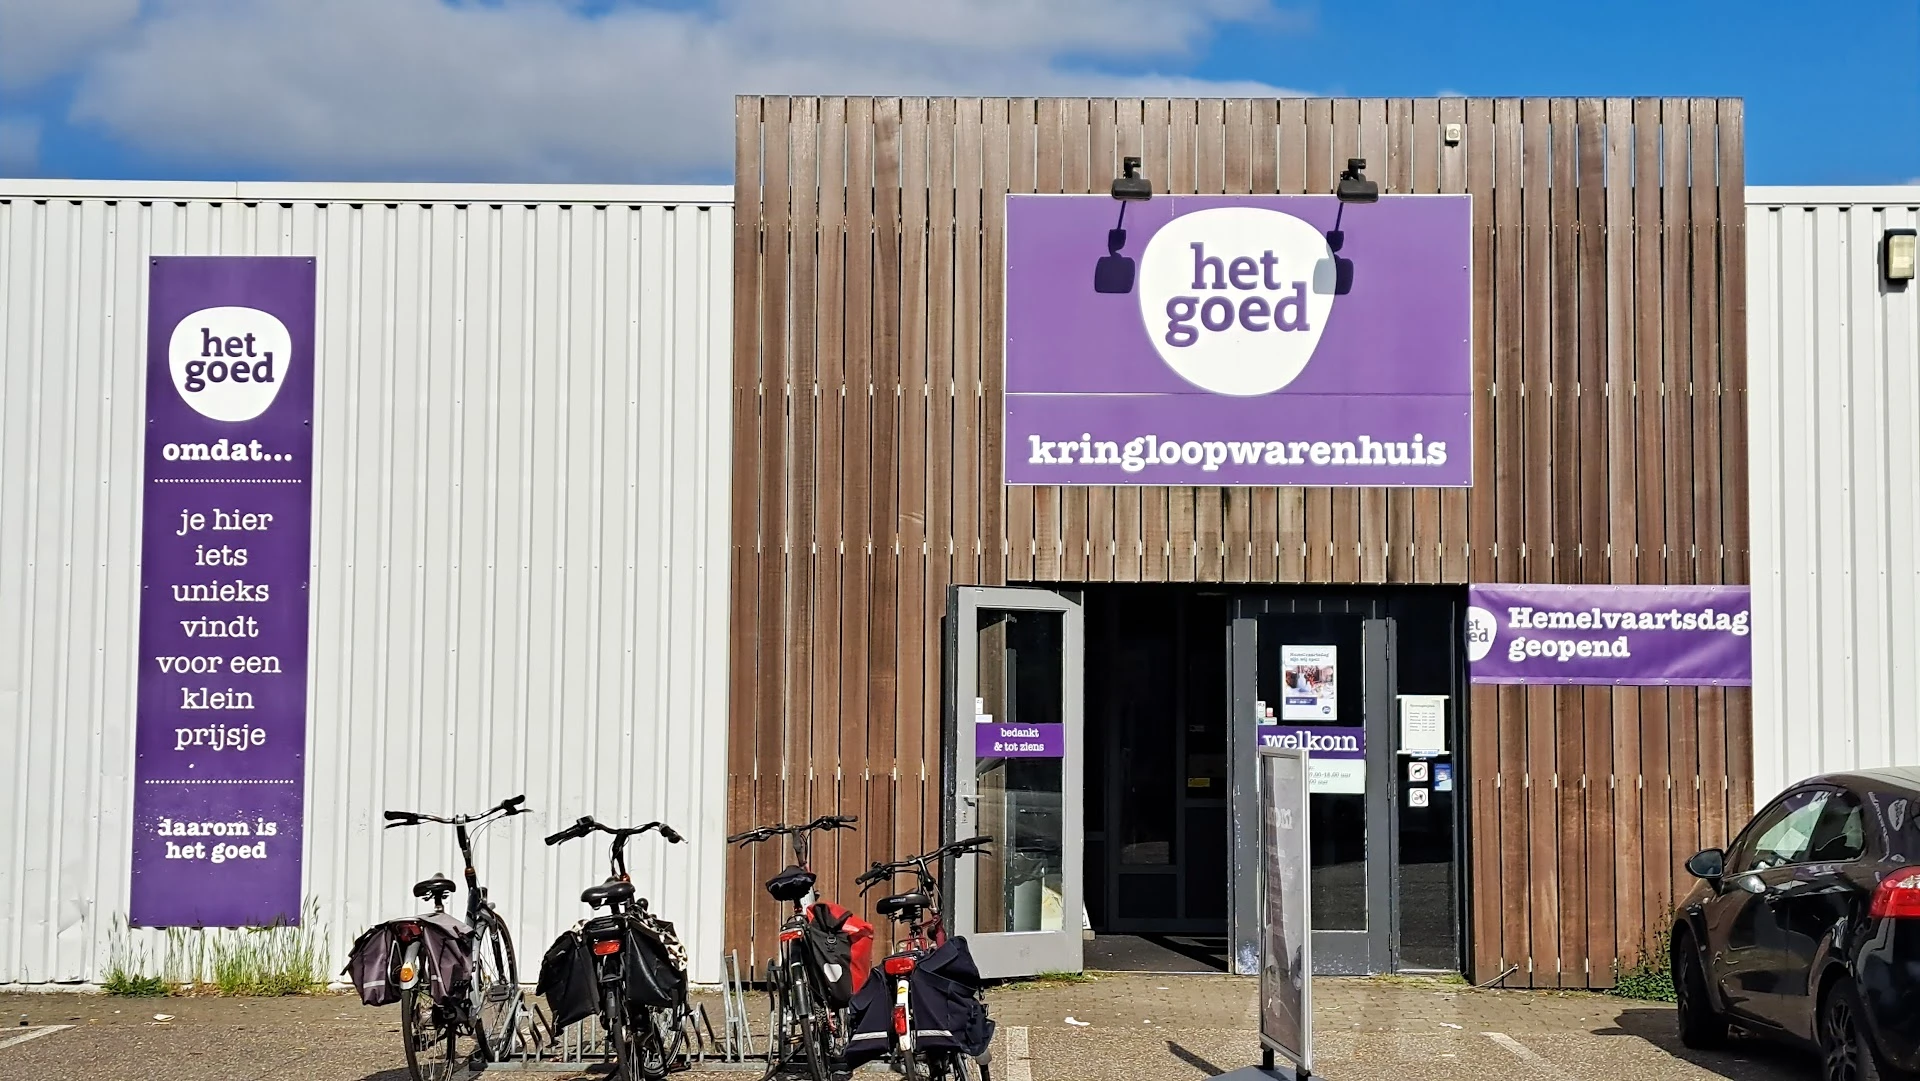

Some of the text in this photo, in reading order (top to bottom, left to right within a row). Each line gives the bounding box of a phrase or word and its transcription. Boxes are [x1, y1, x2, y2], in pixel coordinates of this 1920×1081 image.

[1190, 241, 1281, 291] het
[1165, 281, 1311, 348] goed
[200, 327, 257, 358] het
[184, 351, 275, 393] goed
[162, 439, 293, 462] omdat...
[1028, 433, 1447, 472] kringloopwarenhuis
[176, 508, 273, 536] je hier
[195, 544, 248, 567] iets
[171, 579, 270, 602] unieks
[180, 615, 259, 638] vindt
[1467, 618, 1481, 631] et
[1508, 607, 1749, 636] Hemelvaartsdag
[1508, 636, 1631, 662] geopend
[155, 655, 282, 674] voor een
[181, 687, 255, 710] klein
[174, 723, 266, 752] prijsje
[1000, 727, 1040, 738] bedankt
[1262, 730, 1360, 752] welkom
[993, 741, 1045, 752] & tot ziens
[158, 817, 277, 837] daarom is
[164, 841, 268, 864] het goed
